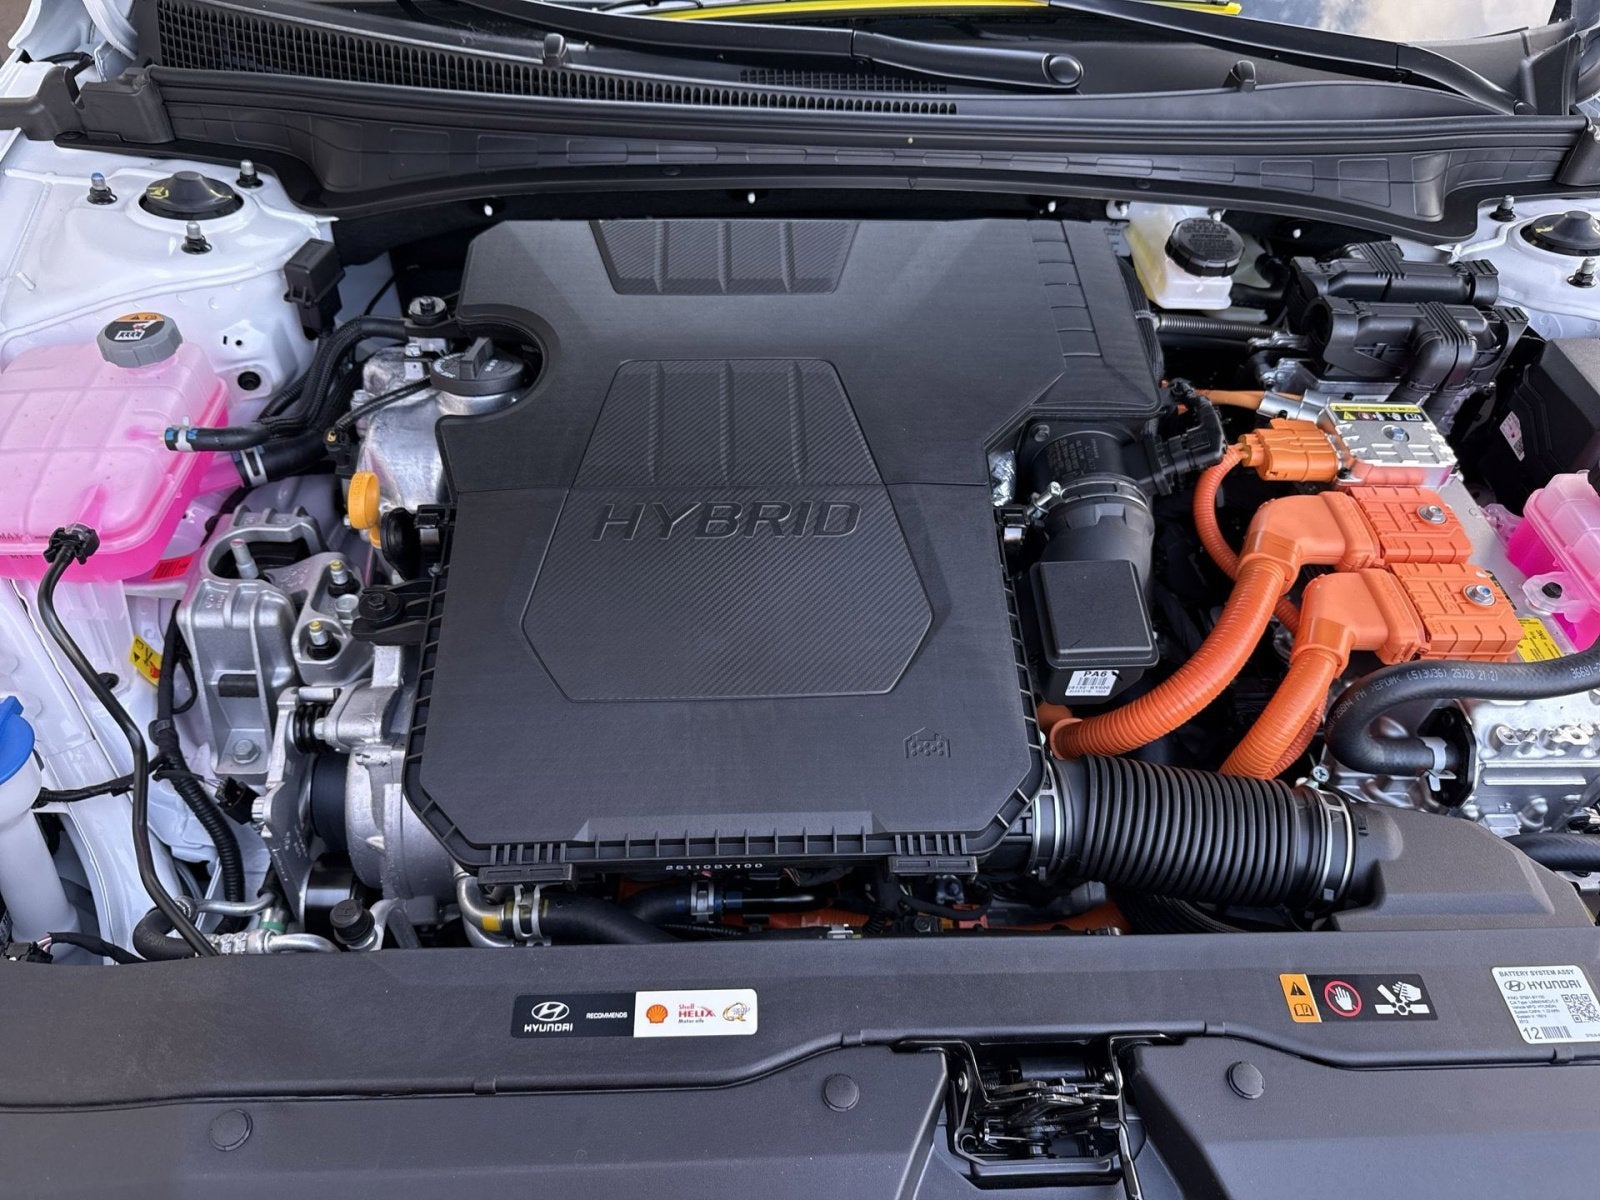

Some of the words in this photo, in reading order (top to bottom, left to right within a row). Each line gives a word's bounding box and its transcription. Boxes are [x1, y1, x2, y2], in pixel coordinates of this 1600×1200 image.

[592, 500, 862, 541] HYBRID
[1526, 979, 1582, 991] HYUNDAI
[586, 1011, 628, 1019] RECOMMENDS
[678, 1009, 714, 1018] HELIX
[524, 1022, 573, 1032] HYUNDAI
[1523, 1026, 1543, 1040] 12
